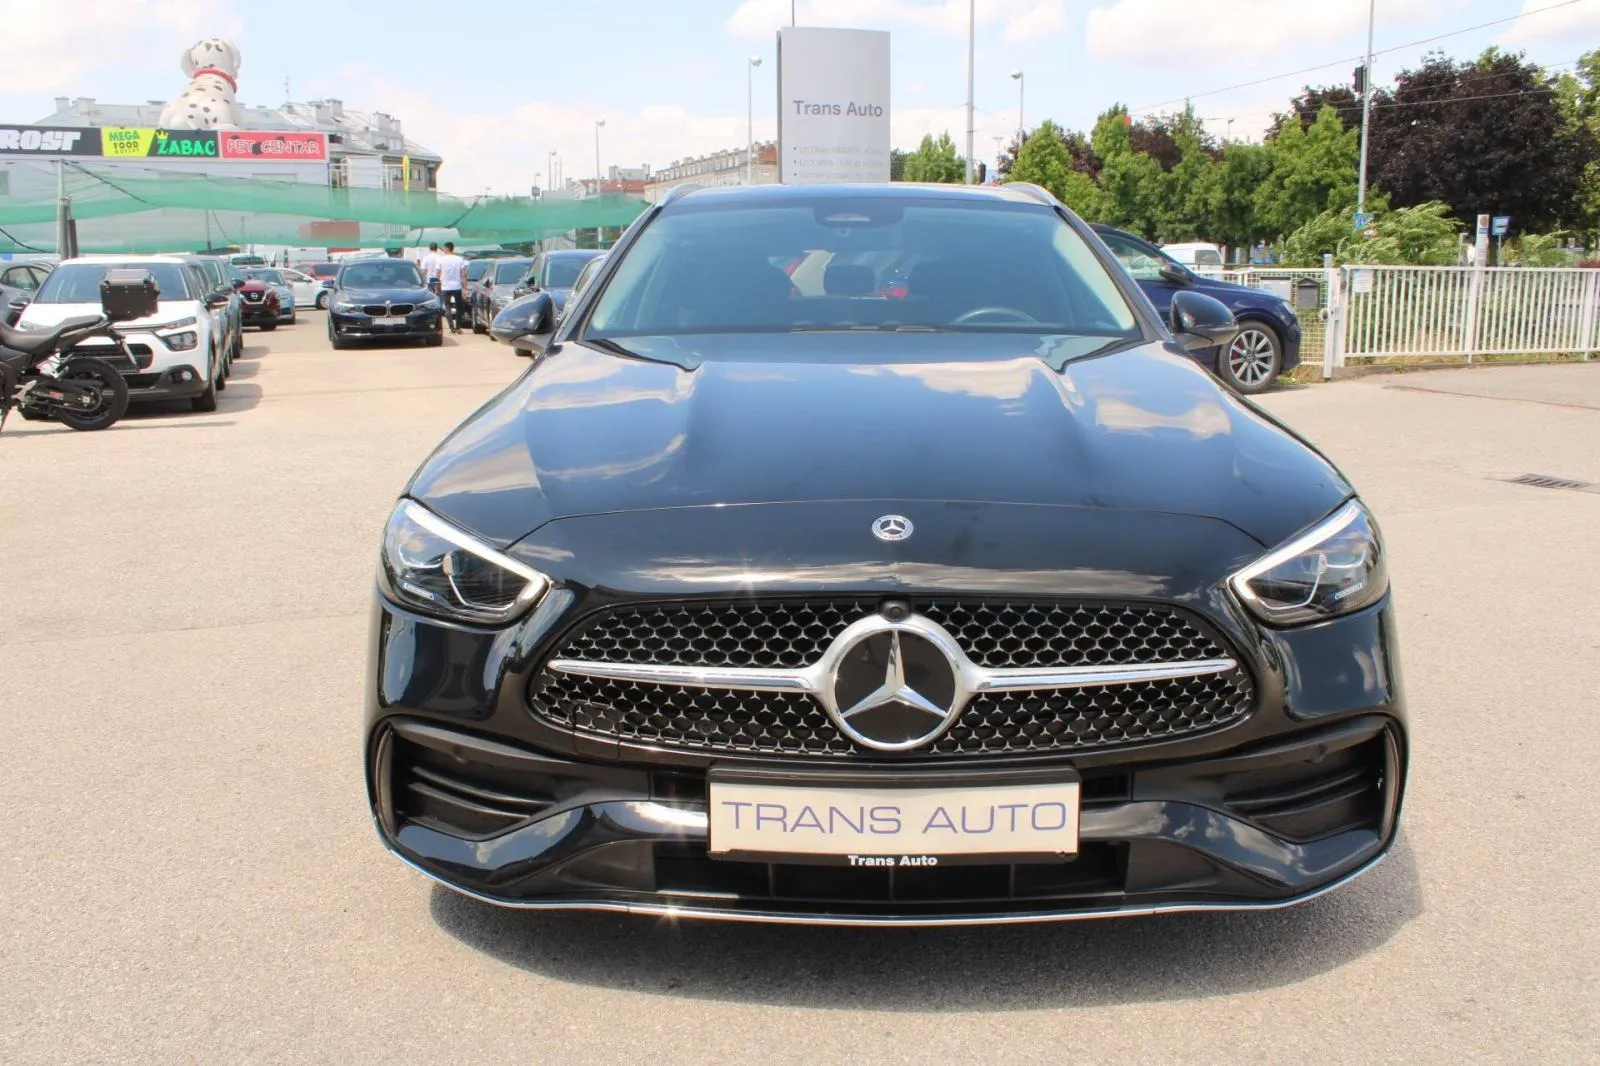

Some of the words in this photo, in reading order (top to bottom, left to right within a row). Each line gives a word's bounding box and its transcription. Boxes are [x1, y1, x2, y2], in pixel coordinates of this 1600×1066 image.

[793, 100, 841, 115] Trans
[846, 101, 883, 117] Auto
[108, 130, 140, 141] MEGA
[113, 141, 139, 149] FOOD
[227, 139, 255, 153] PET
[261, 140, 319, 154] CENTAR
[721, 801, 902, 835] TRANS
[922, 801, 1067, 835] AUTO
[847, 854, 895, 867] Trans
[899, 855, 938, 867] Auto
